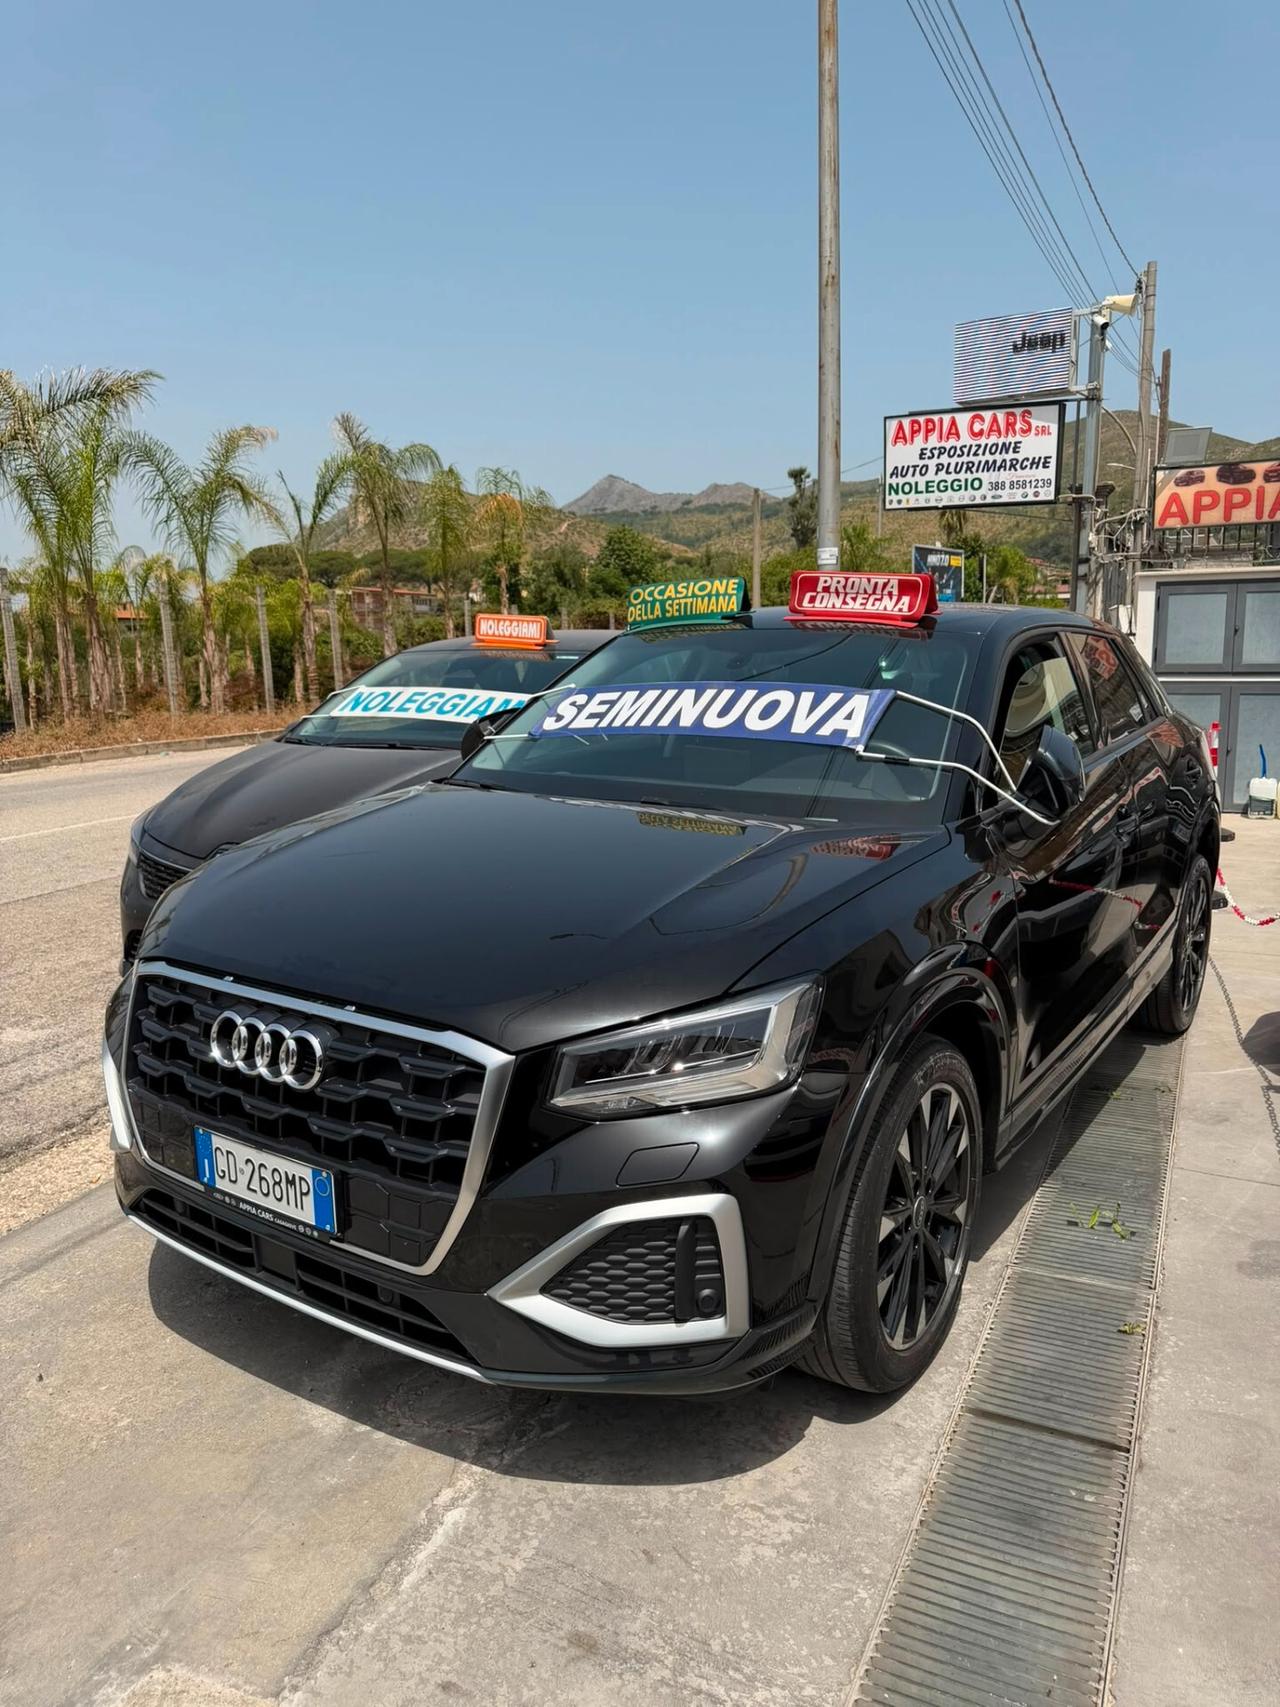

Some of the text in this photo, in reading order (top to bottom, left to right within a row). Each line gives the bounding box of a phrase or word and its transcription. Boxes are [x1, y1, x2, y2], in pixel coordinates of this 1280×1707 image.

[1012, 330, 1066, 353] Jeep
[891, 409, 1052, 447] APPIA CARS SRL
[918, 441, 1022, 461] ESPOSIZIONE
[889, 456, 1052, 479] AUTO PLURIMARCHE
[888, 477, 1052, 496] NOLEGGIO 388 8581239
[630, 579, 739, 604] OCCASIONE
[816, 576, 899, 594] PRONTA
[627, 596, 738, 622] DELLA SETTIMANA
[802, 592, 911, 612] CONSEGNA
[480, 619, 541, 639] NOLEGGIAMI
[543, 689, 871, 739] SEMINUOVA
[257, 1209, 274, 1222] CARS
